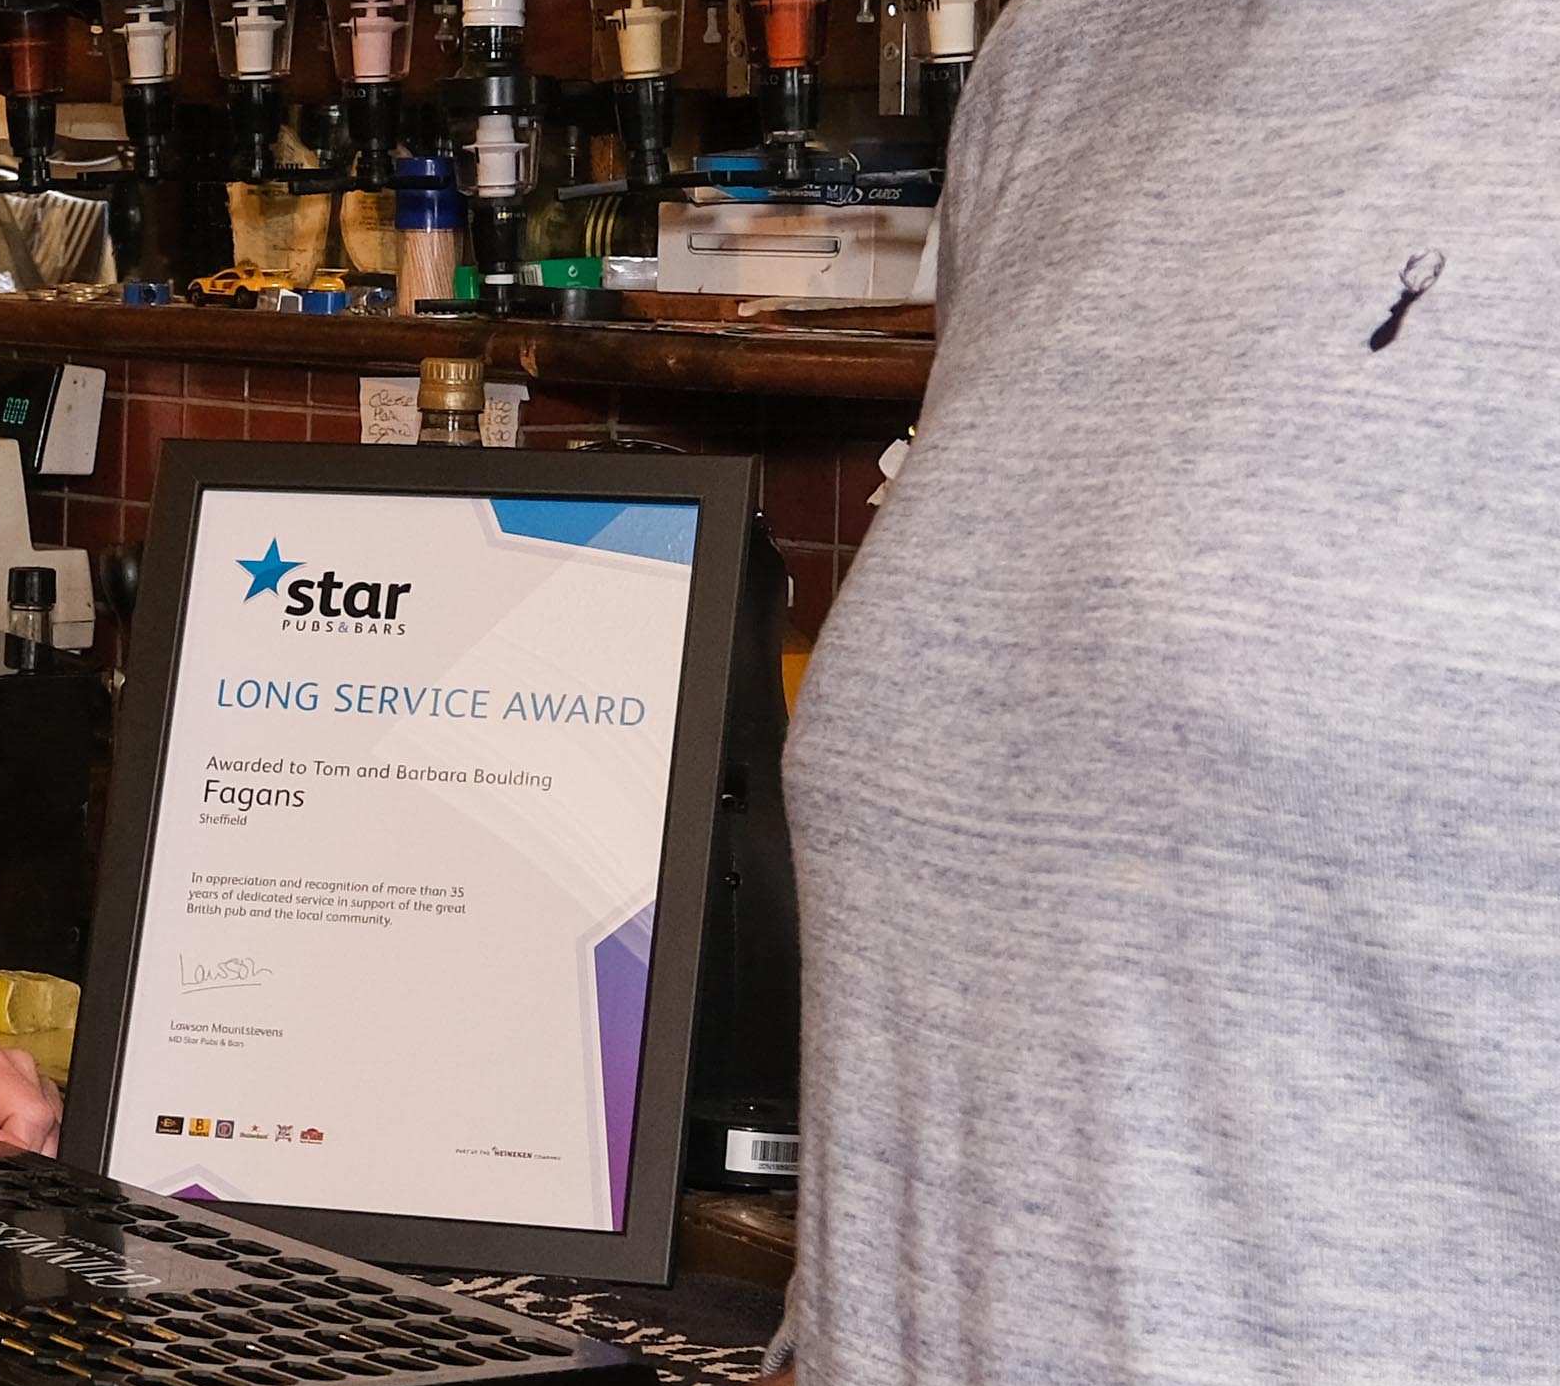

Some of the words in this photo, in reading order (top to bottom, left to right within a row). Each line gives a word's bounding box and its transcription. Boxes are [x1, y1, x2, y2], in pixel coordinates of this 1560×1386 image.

[284, 571, 412, 620] star
[216, 678, 320, 711] LONG
[333, 682, 492, 719] SERVICE
[502, 691, 647, 727] AWARD
[205, 755, 284, 775] Awarded
[288, 760, 308, 776] to
[312, 759, 351, 778] Tom
[356, 762, 391, 780] and
[396, 764, 468, 784] Barbara
[473, 768, 553, 792] Boulding
[202, 779, 305, 813] Fagans
[198, 813, 248, 827] Sheffield
[190, 871, 203, 884] In
[205, 873, 277, 889] appreciation
[278, 877, 302, 889] and
[304, 878, 370, 894] recognition
[370, 881, 386, 893] of
[386, 884, 418, 896] more
[419, 885, 447, 898] than
[450, 886, 465, 899] 35
[185, 902, 222, 916] British
[223, 905, 247, 919] pub
[248, 907, 273, 919] and
[274, 908, 295, 920] the
[295, 909, 324, 922] local
[186, 889, 220, 903] years
[220, 889, 234, 901] of
[235, 890, 293, 905] dedicated
[294, 894, 335, 907] service
[337, 896, 349, 908] in
[350, 897, 396, 912] support
[397, 898, 412, 911] of
[413, 900, 433, 913] the
[435, 903, 467, 916] great
[169, 1019, 210, 1033] Lawson
[210, 1022, 285, 1039] Mountstevens
